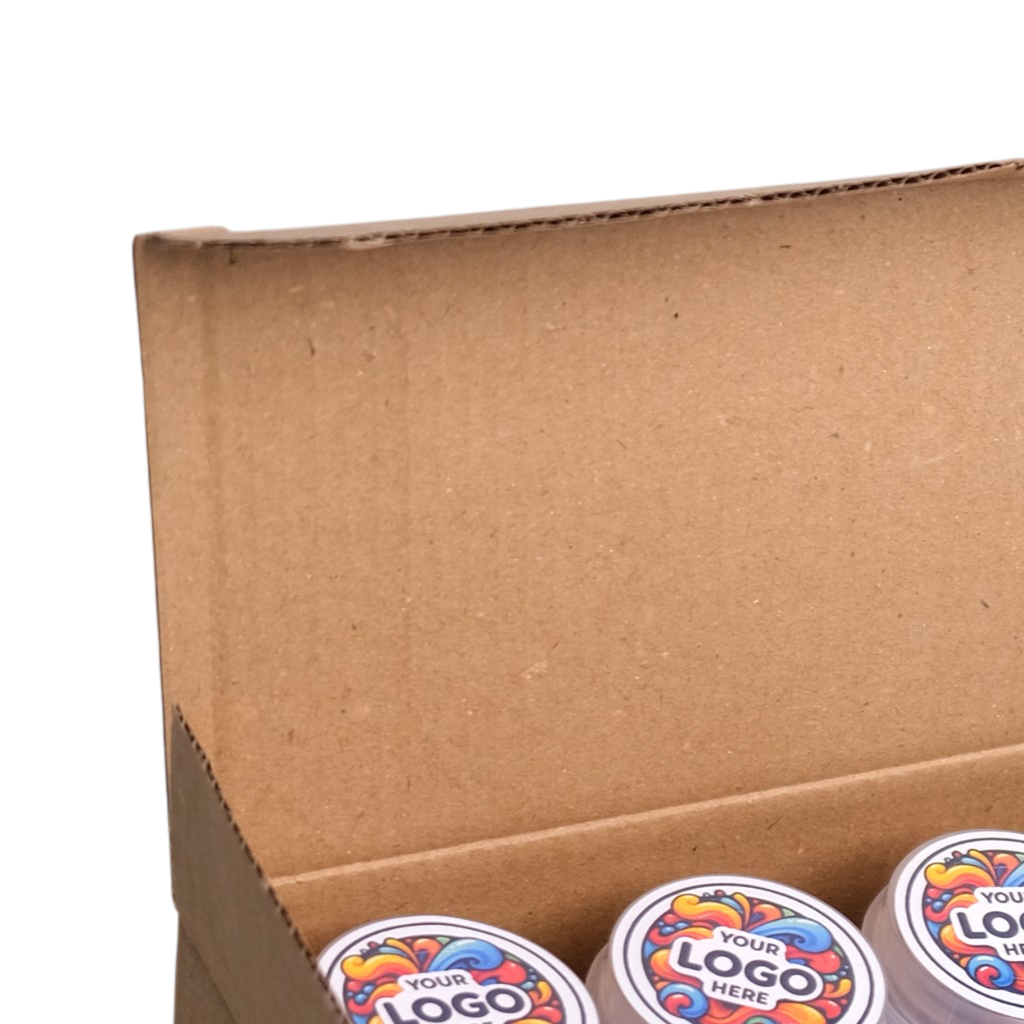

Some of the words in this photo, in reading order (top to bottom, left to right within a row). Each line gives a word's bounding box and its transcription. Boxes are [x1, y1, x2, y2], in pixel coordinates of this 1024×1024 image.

[720, 931, 780, 956] YOUR
[677, 941, 817, 997] LOGO
[405, 974, 468, 991] YOUR
[711, 980, 769, 1005] HERE
